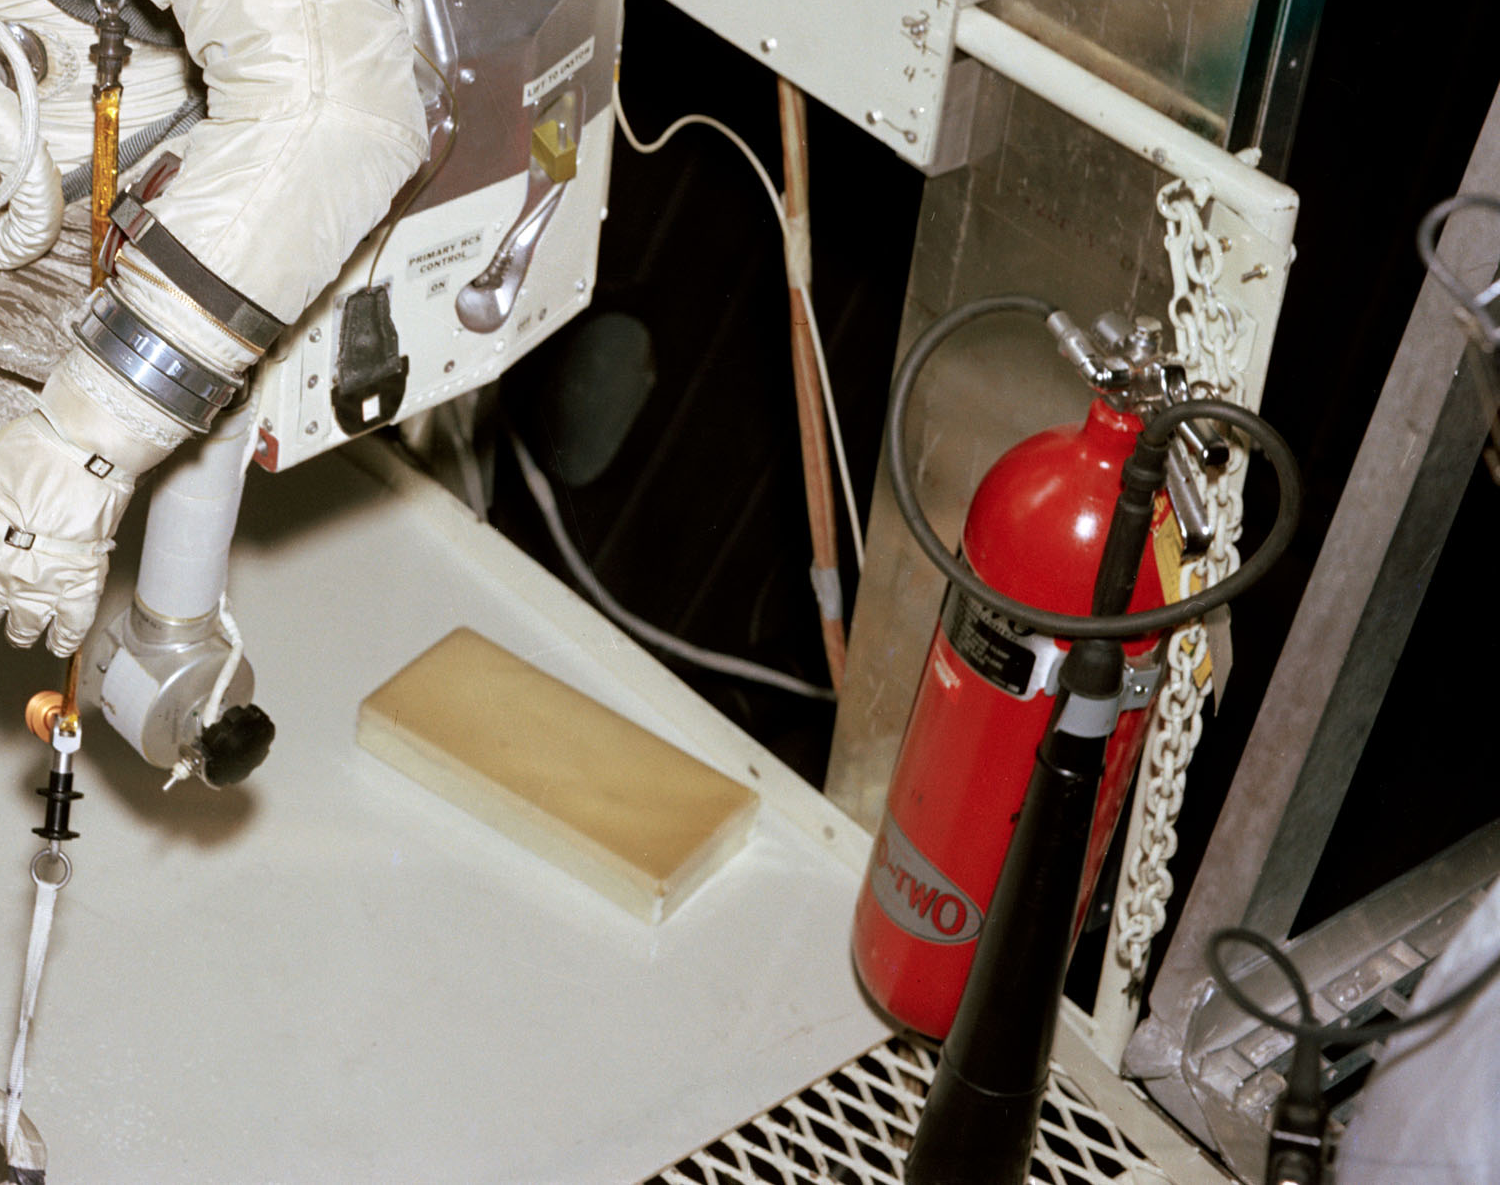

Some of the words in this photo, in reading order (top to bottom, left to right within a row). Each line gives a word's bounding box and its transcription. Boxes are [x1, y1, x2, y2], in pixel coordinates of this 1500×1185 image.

[408, 244, 455, 266] PRIMARY
[461, 234, 481, 248] RCS
[420, 250, 466, 273] CONTROL
[431, 280, 445, 292] ON
